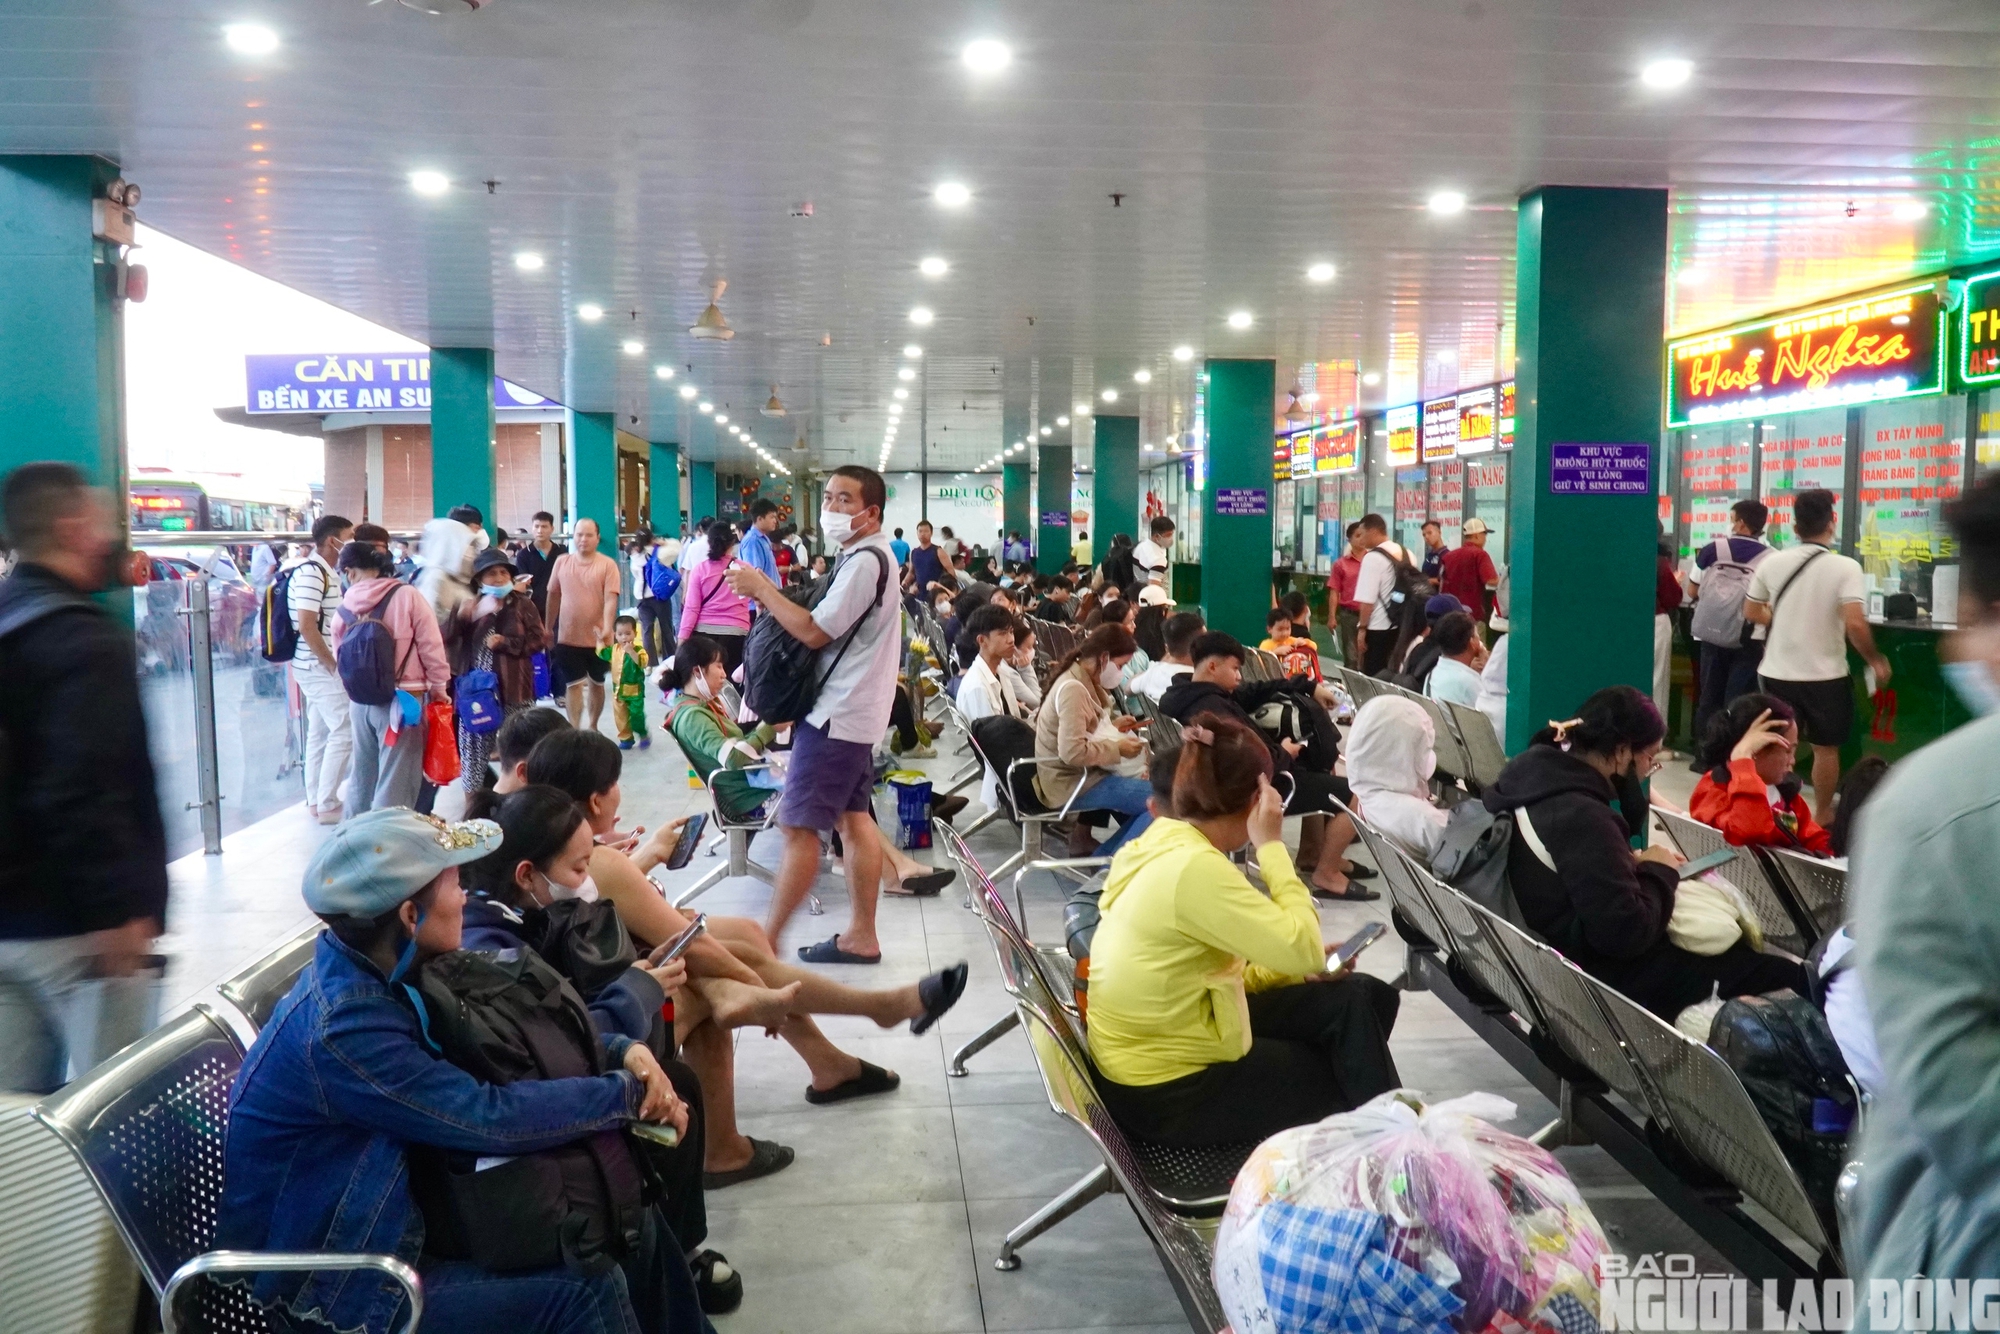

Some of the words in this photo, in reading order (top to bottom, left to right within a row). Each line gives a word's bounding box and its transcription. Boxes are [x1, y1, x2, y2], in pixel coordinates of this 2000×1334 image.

[1970, 309, 2000, 343] TH
[1772, 325, 1910, 391] Nghĩa
[295, 356, 373, 382] CĂN
[258, 384, 308, 409] BẾN
[316, 389, 349, 408] XE
[355, 389, 392, 407] AN
[400, 388, 431, 406] SU
[1877, 430, 1890, 442] BX
[1894, 425, 1912, 440] TÂY
[1916, 424, 1944, 438] NINH
[1580, 447, 1600, 456] KHU
[1603, 446, 1622, 458] VỰC
[1861, 451, 1882, 463] LONG
[1555, 456, 1589, 468] KHÔNG
[1592, 457, 1612, 468] HÚT
[1614, 455, 1646, 468] THUỐC
[1580, 471, 1595, 480] VUI
[1598, 470, 1622, 479] LÒNG
[1554, 479, 1571, 490] GIỮ
[1574, 480, 1586, 490] VỆ
[1589, 481, 1611, 490] SINH
[1613, 481, 1645, 490] CHUNG
[1872, 688, 1896, 742] 22
